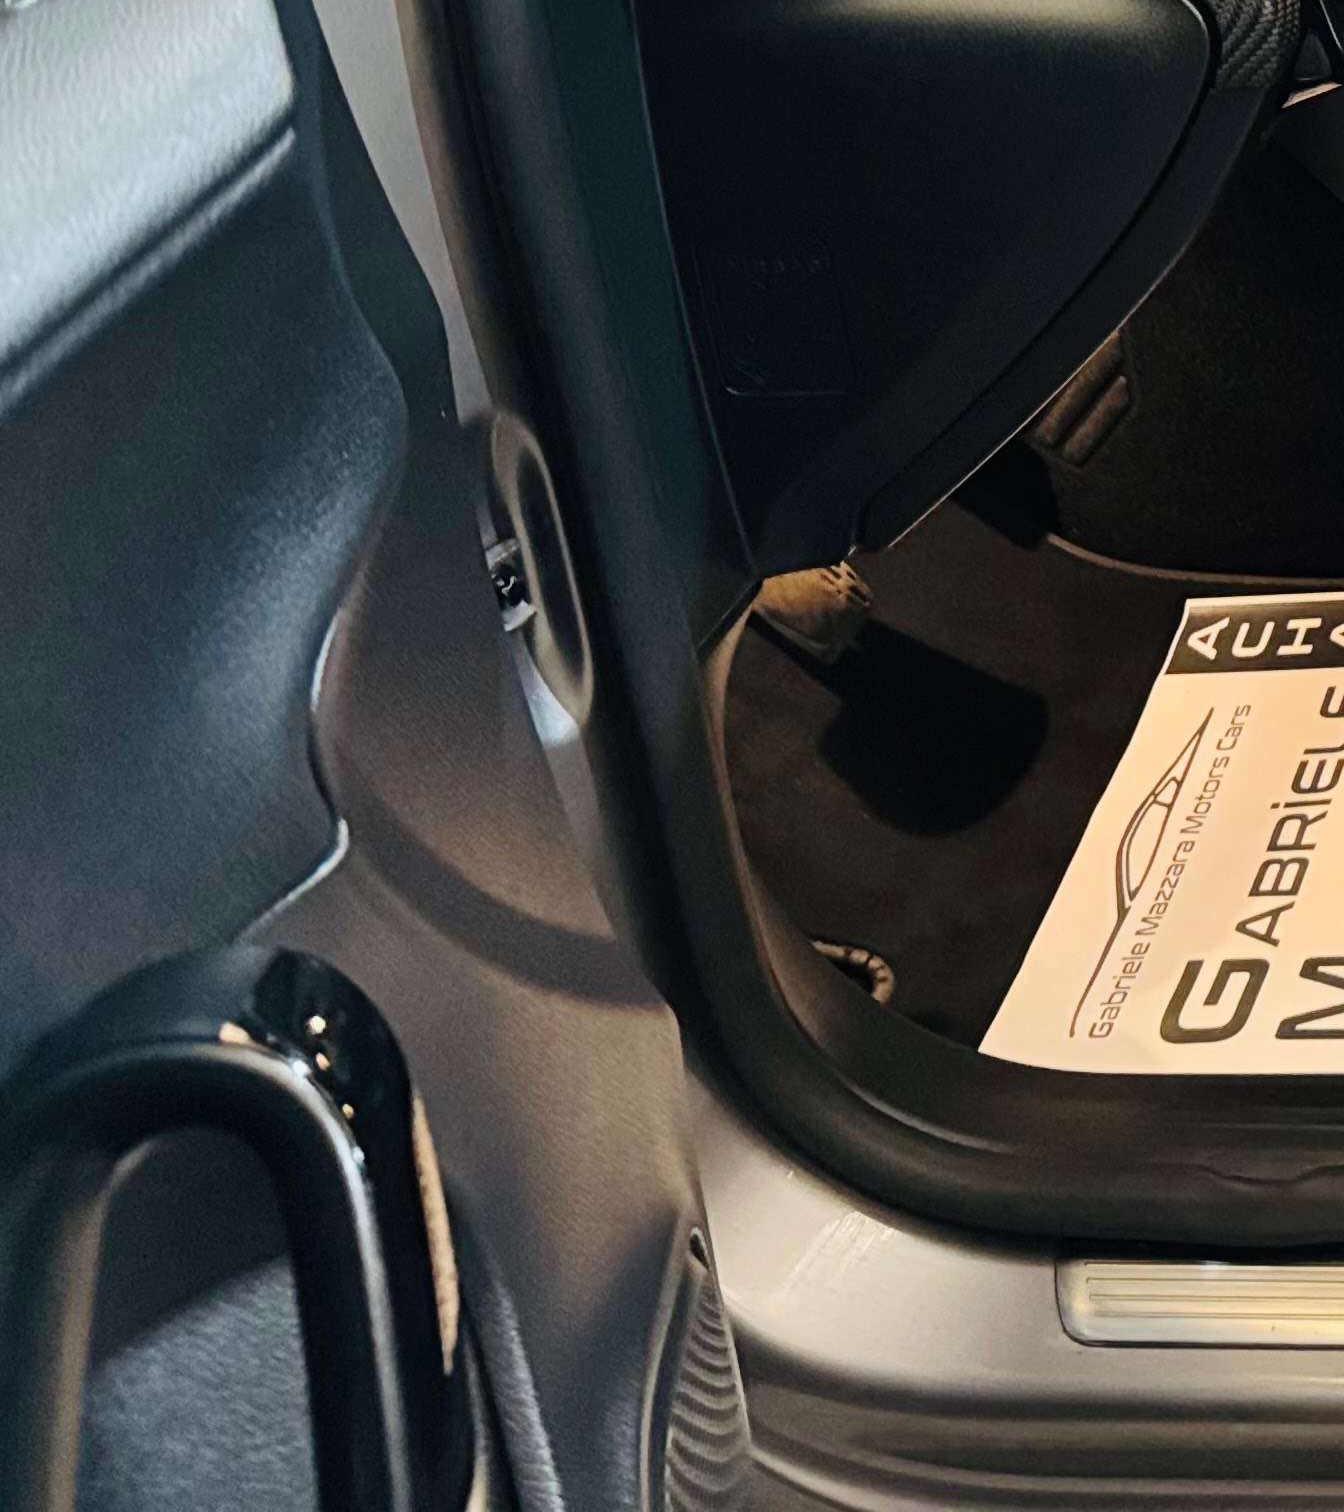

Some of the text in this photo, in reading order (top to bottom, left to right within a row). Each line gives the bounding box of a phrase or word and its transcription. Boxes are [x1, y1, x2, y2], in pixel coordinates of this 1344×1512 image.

[1088, 704, 1252, 1039] Gabriele Mazzara Motors Cars
